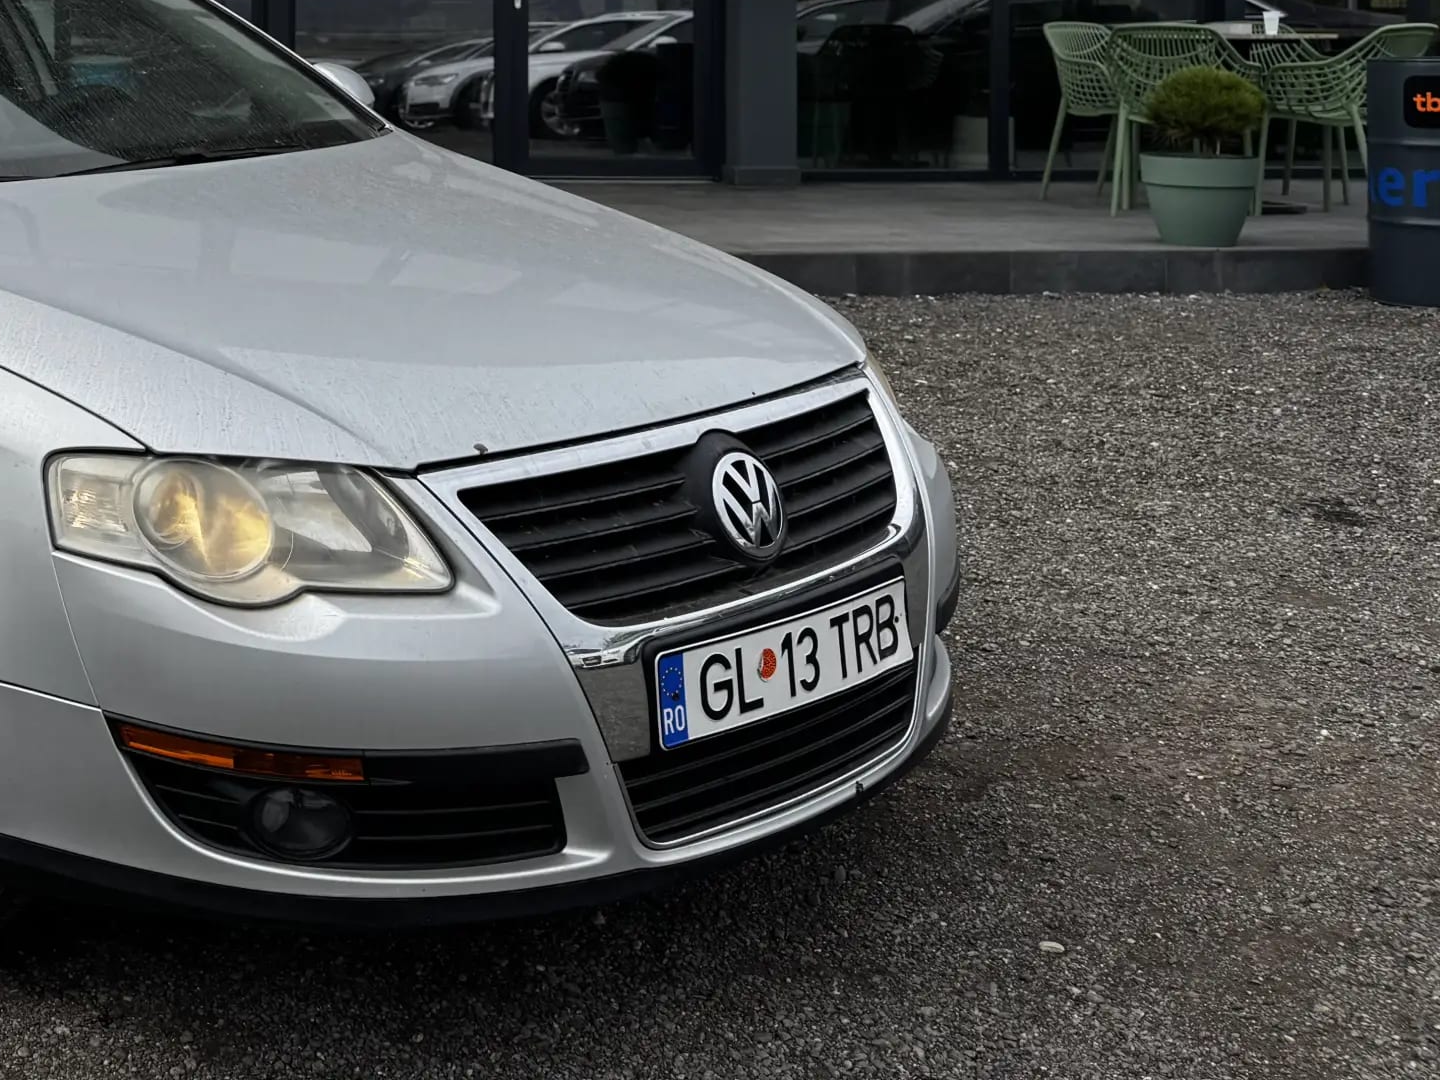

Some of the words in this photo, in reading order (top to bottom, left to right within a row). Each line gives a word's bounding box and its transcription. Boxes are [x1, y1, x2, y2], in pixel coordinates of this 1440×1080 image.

[1369, 167, 1440, 207] er
[715, 454, 782, 554] VW
[699, 647, 765, 721] GL
[781, 627, 820, 697] 13
[830, 594, 899, 679] TRB
[663, 704, 686, 736] RO
